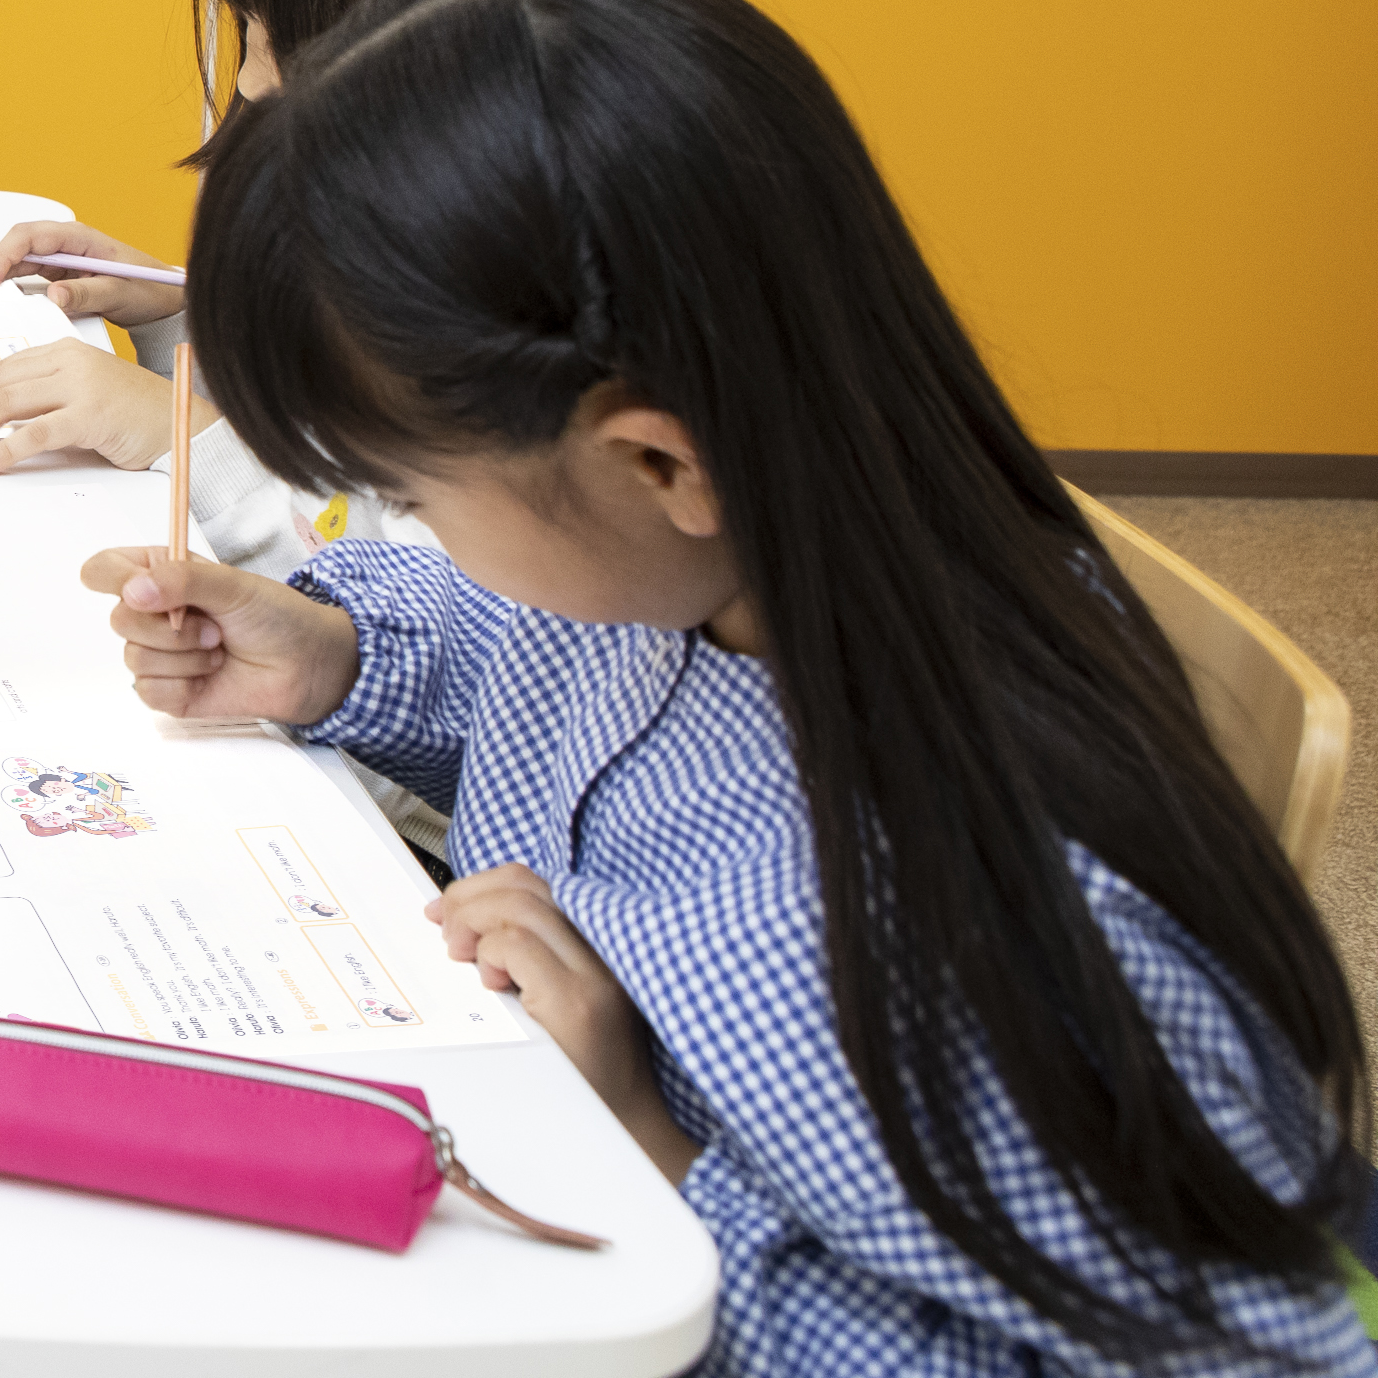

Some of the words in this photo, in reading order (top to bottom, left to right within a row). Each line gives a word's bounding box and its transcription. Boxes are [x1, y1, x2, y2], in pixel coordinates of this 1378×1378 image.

[137, 903, 158, 927] subject.
[152, 926, 173, 953] favorite
[194, 933, 212, 953] math.
[124, 942, 139, 961] really
[221, 945, 234, 958] me.
[134, 960, 153, 982] English
[210, 963, 231, 981] don't
[344, 952, 367, 976] English.
[147, 981, 165, 1002] speak
[166, 979, 181, 993] you.
[181, 974, 200, 997] English.
[202, 976, 220, 996] math.
[233, 966, 262, 999] interesting
[107, 973, 148, 1030] Conversation
[174, 994, 192, 1013] Thank
[225, 987, 249, 1010] Really?
[276, 968, 320, 1020] Expressions
[161, 1002, 173, 1015] You
[468, 1012, 484, 1022] 20
[171, 1020, 189, 1040] Olivia
[228, 1017, 246, 1037] Olivia
[266, 1014, 285, 1035] Olivia
